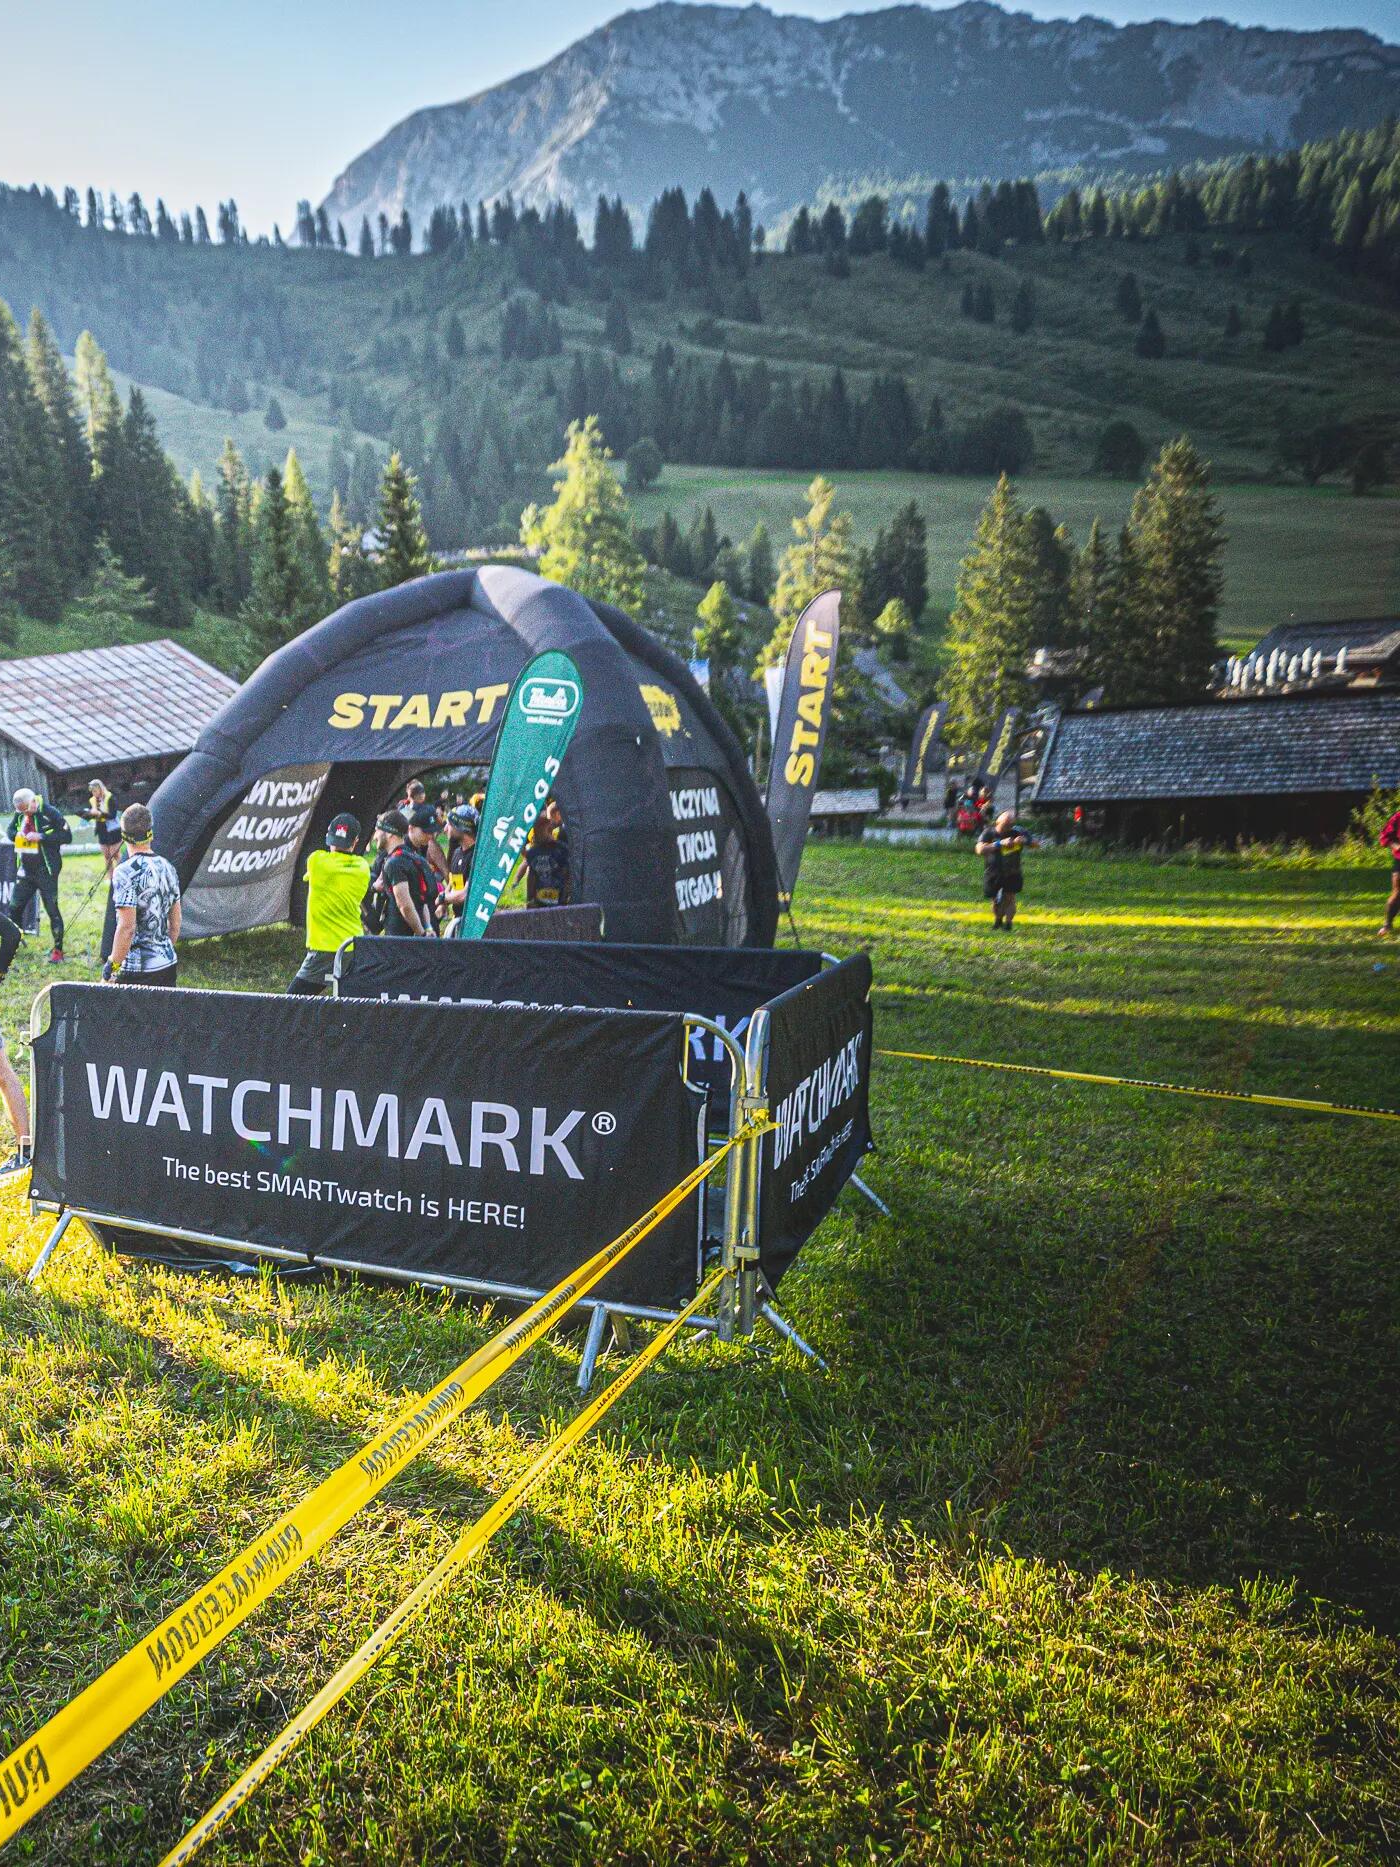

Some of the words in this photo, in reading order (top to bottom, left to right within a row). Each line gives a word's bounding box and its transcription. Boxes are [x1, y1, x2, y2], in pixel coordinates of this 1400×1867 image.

[327, 682, 509, 731] START
[784, 619, 833, 787] START
[475, 755, 560, 922] FILZMOOS
[162, 1156, 201, 1181] The
[204, 1163, 252, 1190] best
[256, 1170, 412, 1213] SMARTwatch
[419, 1193, 440, 1218] is
[448, 1197, 526, 1229] HERE!
